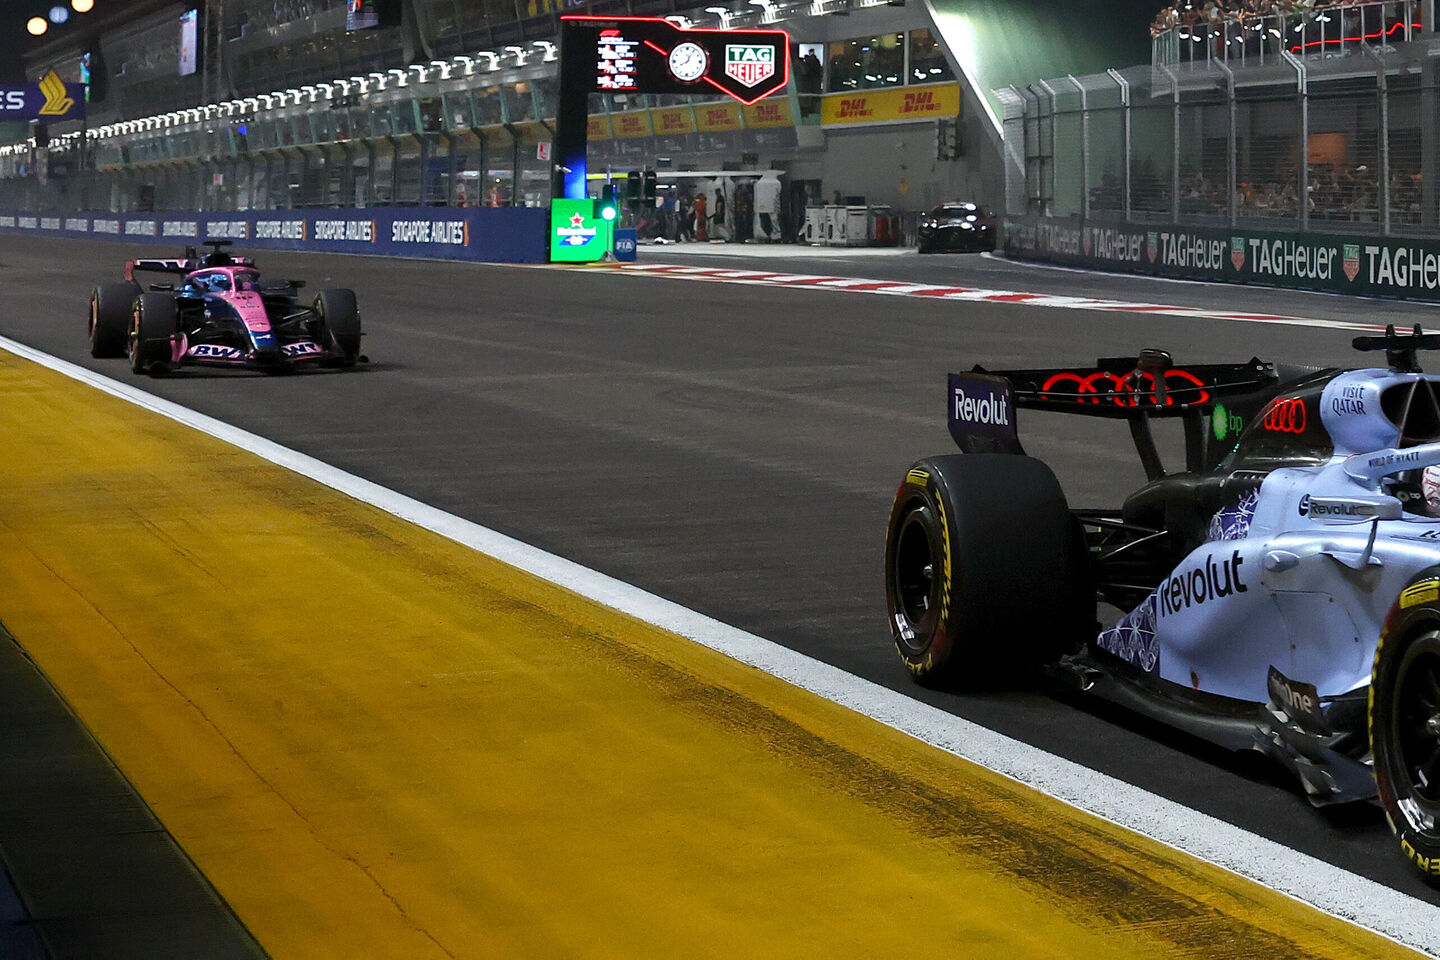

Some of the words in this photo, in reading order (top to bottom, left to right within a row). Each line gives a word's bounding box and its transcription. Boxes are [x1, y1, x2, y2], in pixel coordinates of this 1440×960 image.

[731, 48, 771, 62] TAG
[728, 63, 772, 82] HEUER
[841, 98, 867, 118] DHL
[903, 92, 934, 113] DHL
[392, 220, 430, 243] SINGAPORE
[431, 221, 464, 245] AIRLINES
[616, 241, 632, 250] FIA
[1342, 383, 1366, 400] visit
[954, 387, 1009, 427] Revolut
[1331, 397, 1367, 416] QATAR
[1228, 412, 1243, 436] bp
[1396, 451, 1421, 466] HYATT
[1310, 501, 1358, 517] Revolut
[1160, 549, 1249, 618] Revolut
